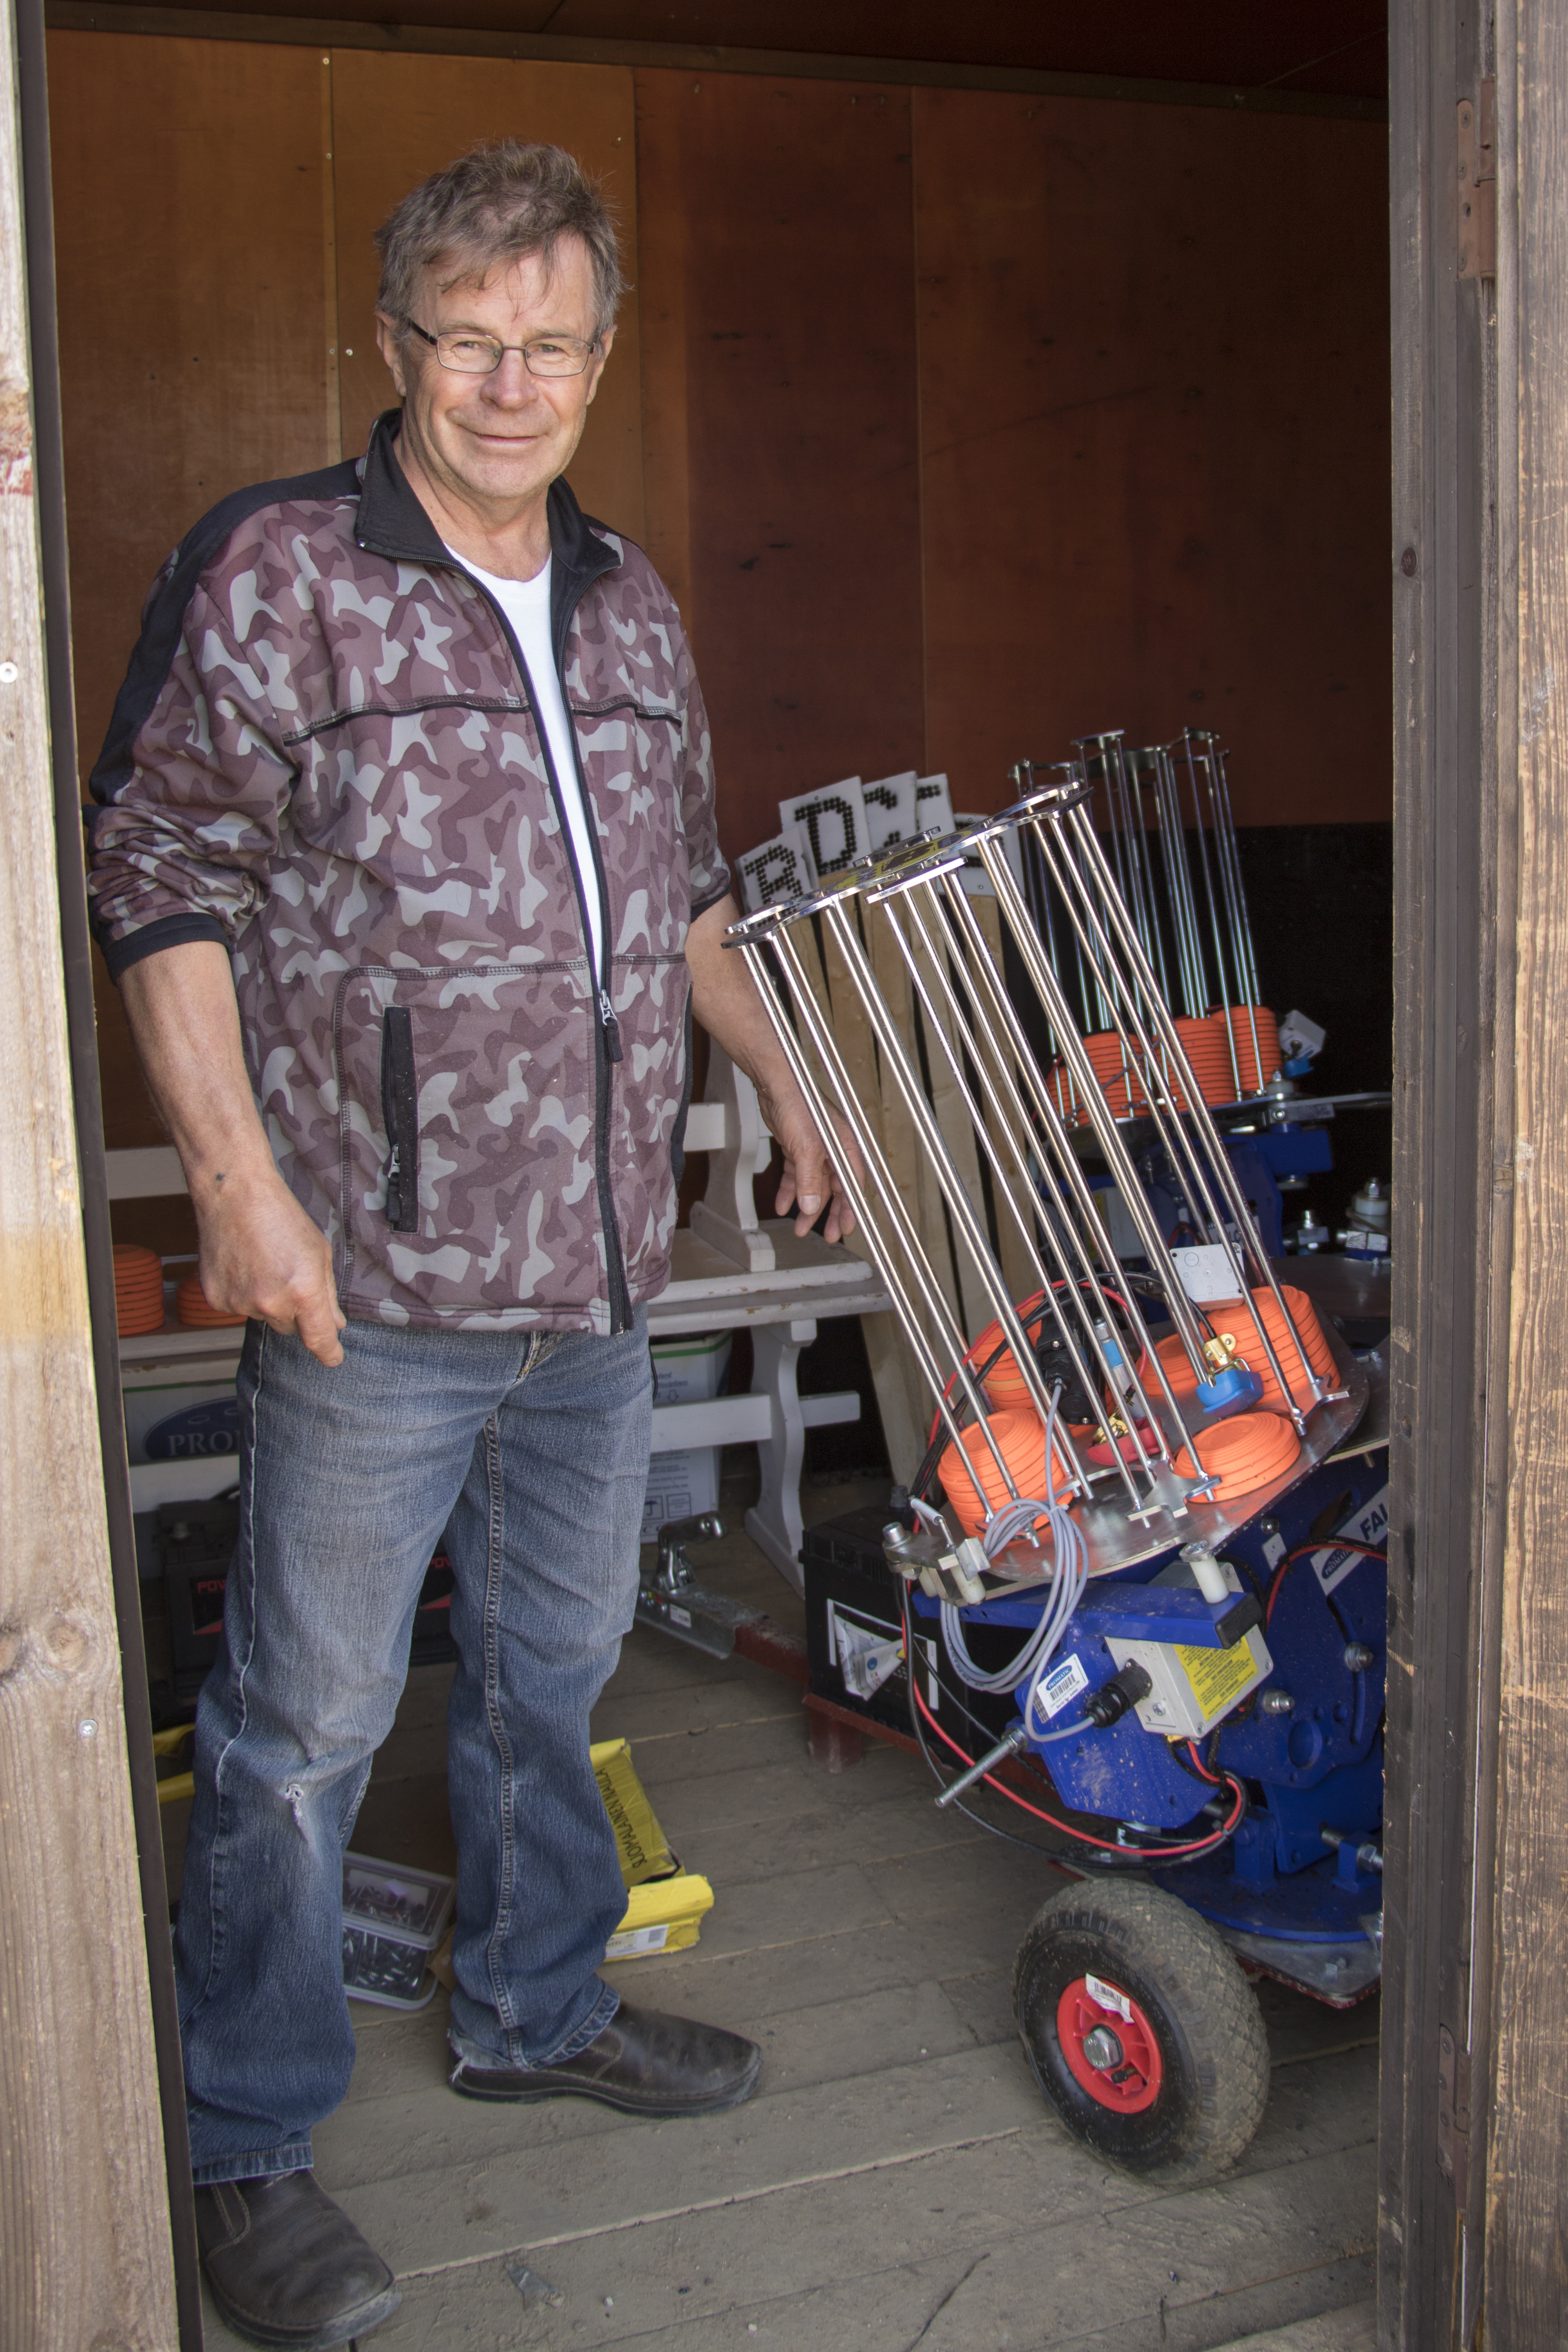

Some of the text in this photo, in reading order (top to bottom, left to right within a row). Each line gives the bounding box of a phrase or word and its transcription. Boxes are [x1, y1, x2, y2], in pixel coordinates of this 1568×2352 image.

[795, 797, 857, 876] D
[168, 1430, 241, 1457] PRO
[1360, 1503, 1388, 1541] FAL
[1325, 1550, 1351, 1575] PROMATI
[1047, 1668, 1070, 1689] PROMATIC
